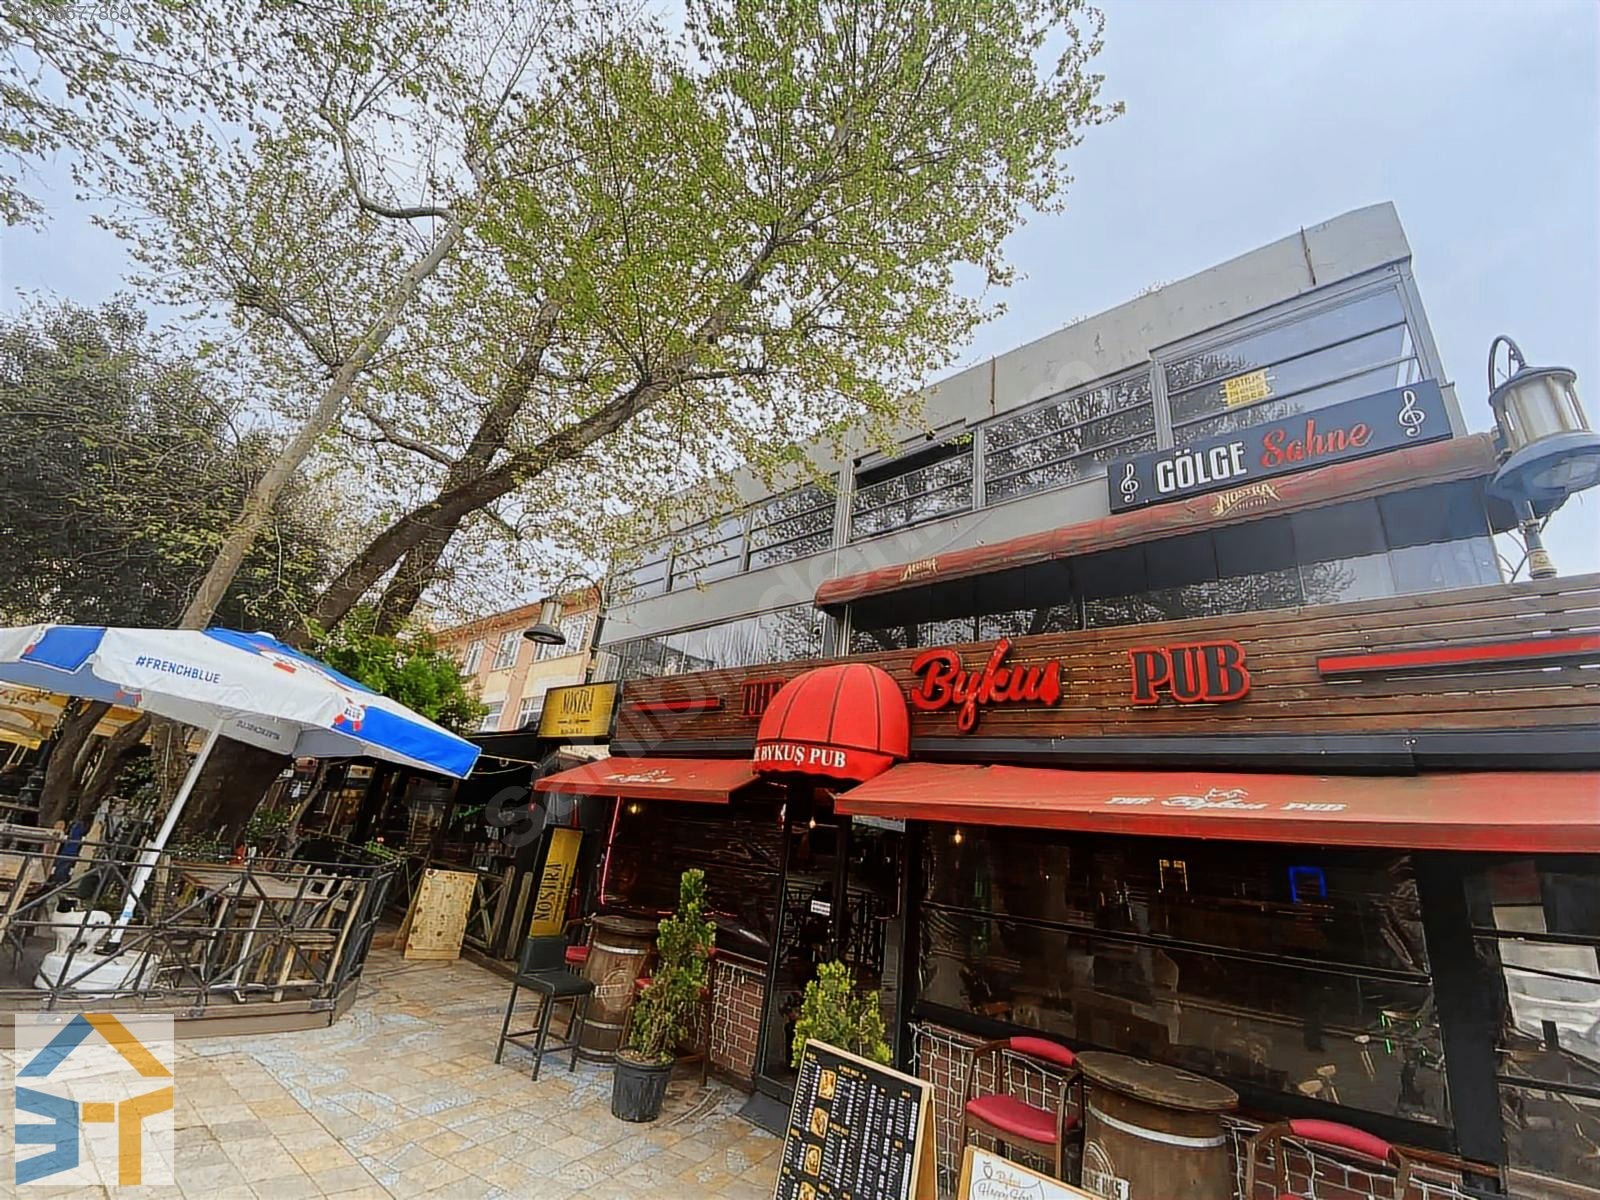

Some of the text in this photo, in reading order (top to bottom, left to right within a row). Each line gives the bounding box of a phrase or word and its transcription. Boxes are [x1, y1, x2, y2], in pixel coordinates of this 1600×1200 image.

[1155, 417, 1374, 494] GÖLGE Sahne
[135, 655, 221, 685] #FRENCHBLUE
[1128, 640, 1249, 705] PUB
[761, 745, 805, 766] BYKUŞ
[808, 747, 846, 768] PUB
[533, 862, 562, 921] NOSTRA
